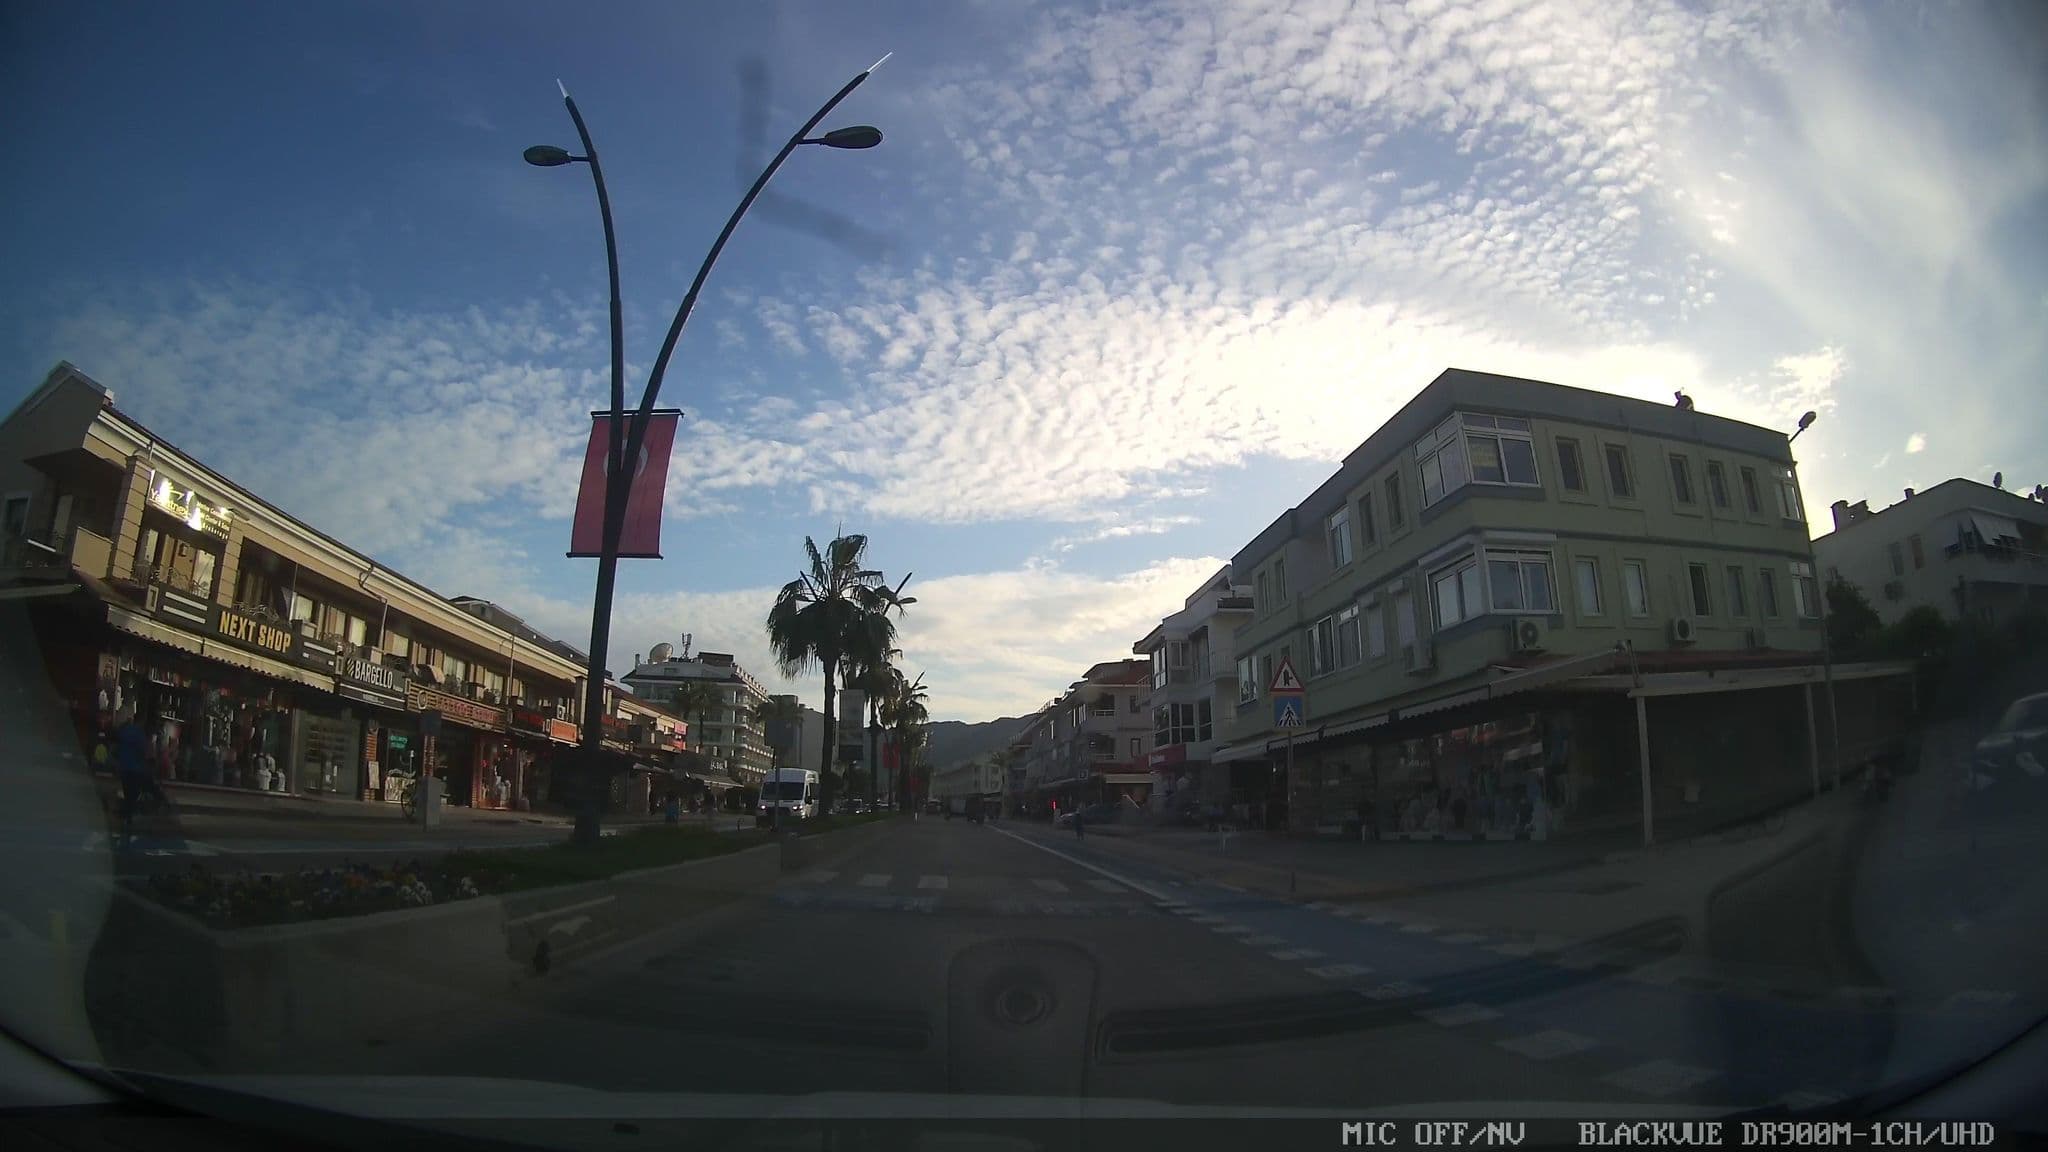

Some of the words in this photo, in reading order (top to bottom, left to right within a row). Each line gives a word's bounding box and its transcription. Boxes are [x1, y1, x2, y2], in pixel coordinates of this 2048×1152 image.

[219, 611, 257, 642] NEXT
[257, 624, 292, 653] SHOP
[355, 660, 393, 689] BARGELLO
